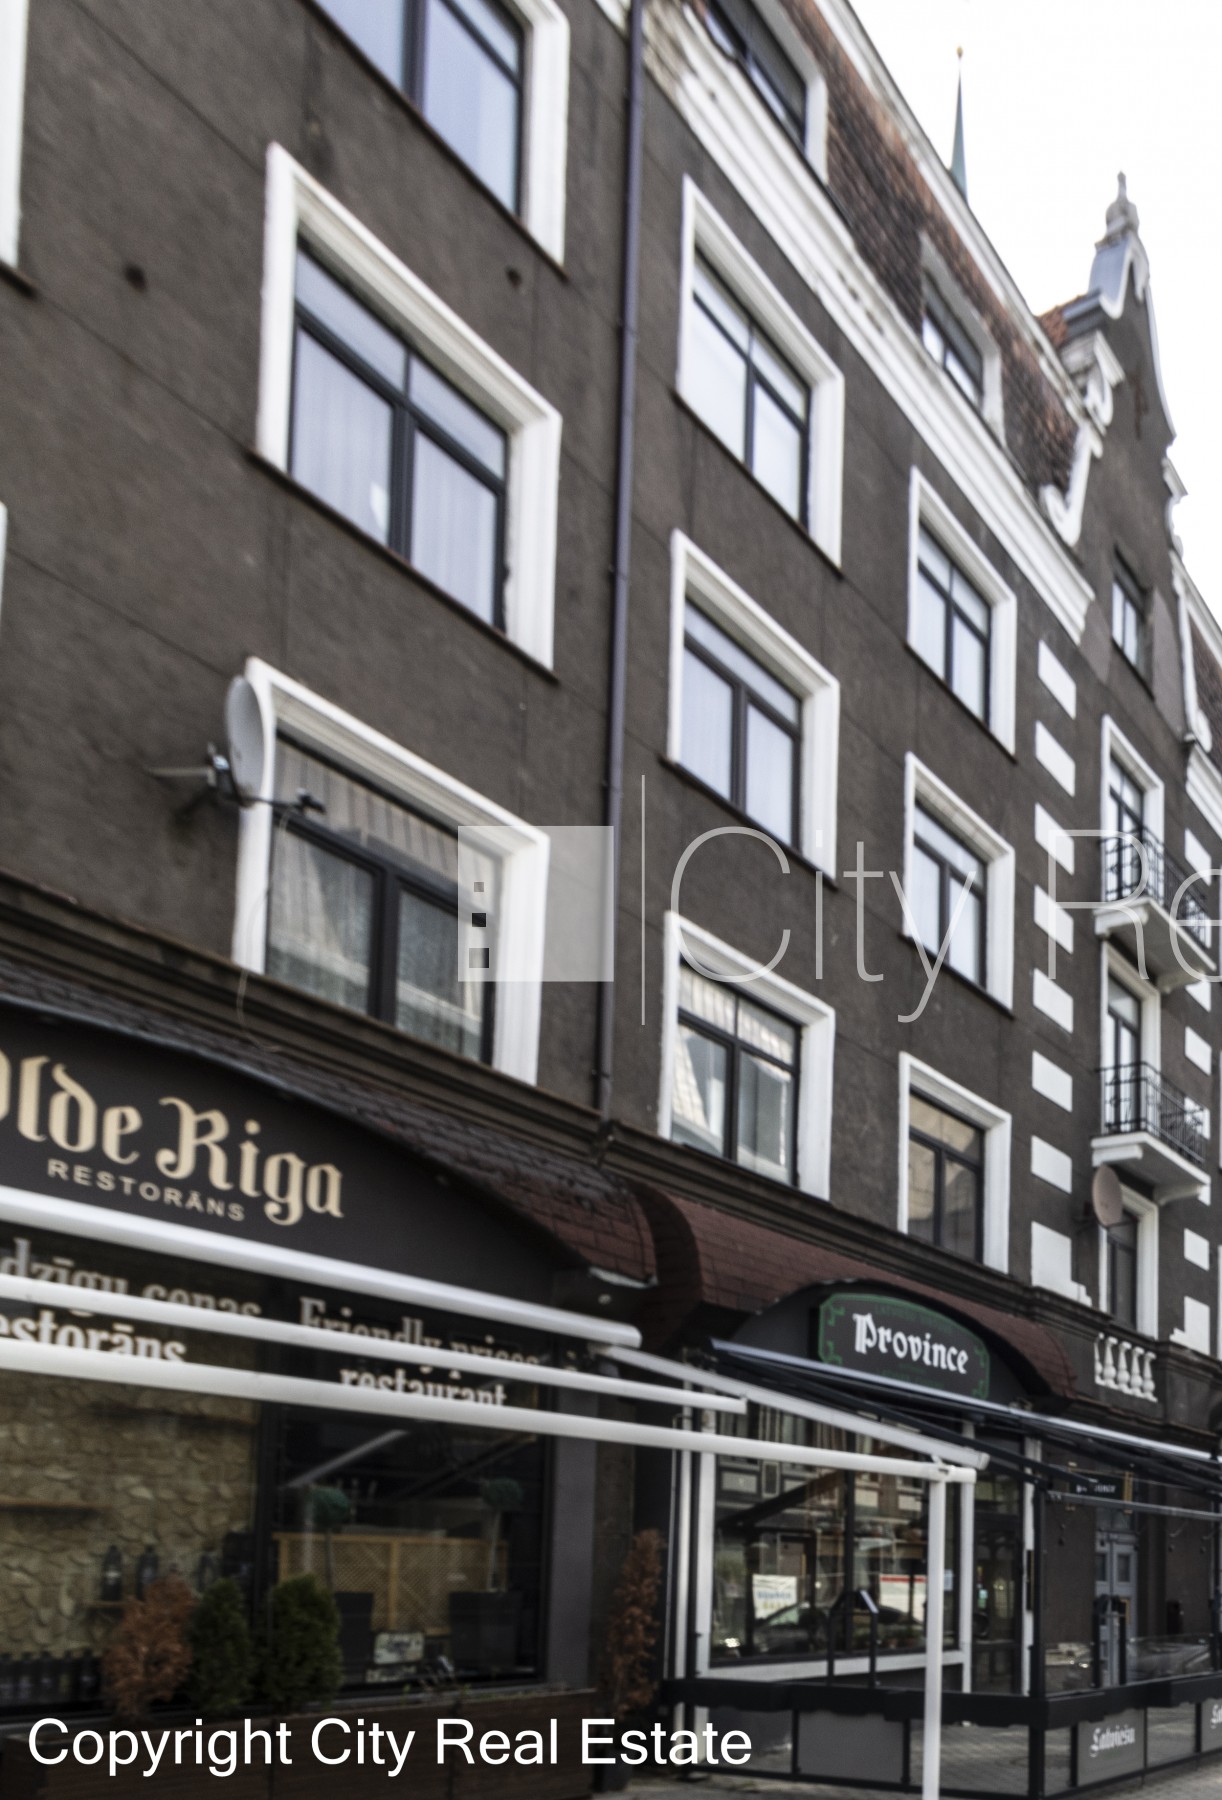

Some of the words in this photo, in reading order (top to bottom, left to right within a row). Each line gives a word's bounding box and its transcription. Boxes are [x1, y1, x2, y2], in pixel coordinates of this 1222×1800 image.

[47, 1158, 246, 1222] RESTORĀNS
[155, 1096, 344, 1226] Riga
[852, 1312, 969, 1375] Province
